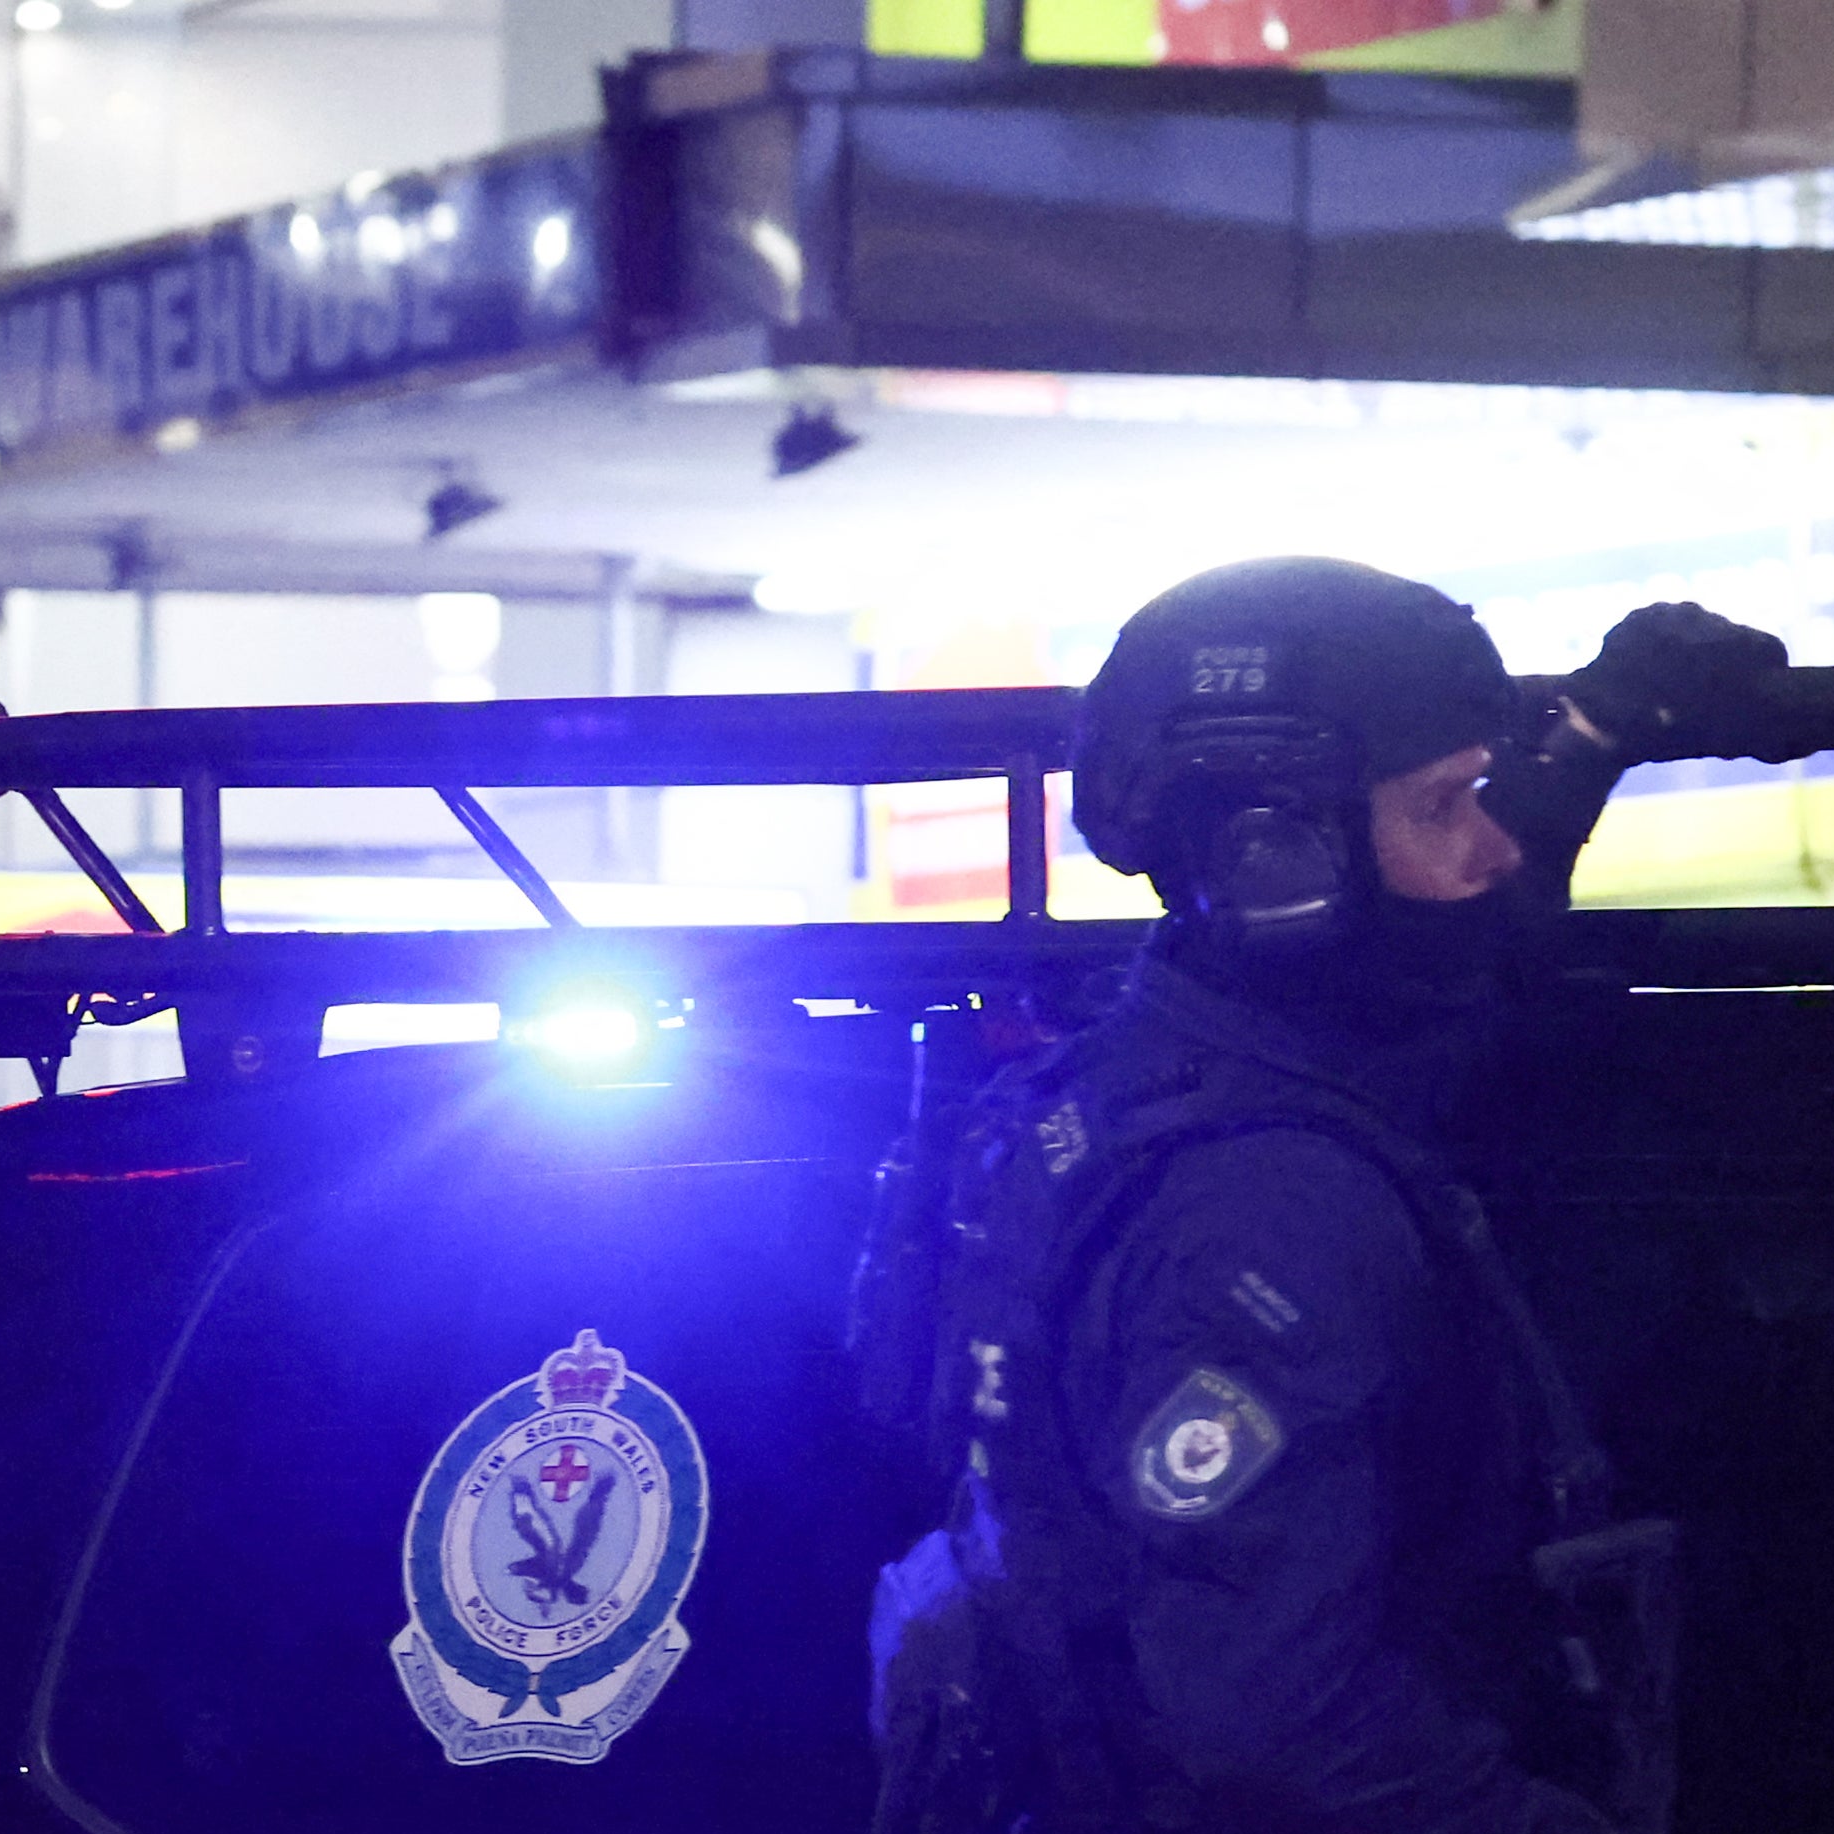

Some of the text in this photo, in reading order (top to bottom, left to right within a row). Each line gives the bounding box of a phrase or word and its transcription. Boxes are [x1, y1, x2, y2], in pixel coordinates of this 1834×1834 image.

[1191, 667, 1267, 694] 279
[525, 1415, 597, 1444] SOUTH
[465, 1596, 529, 1649] POLICE
